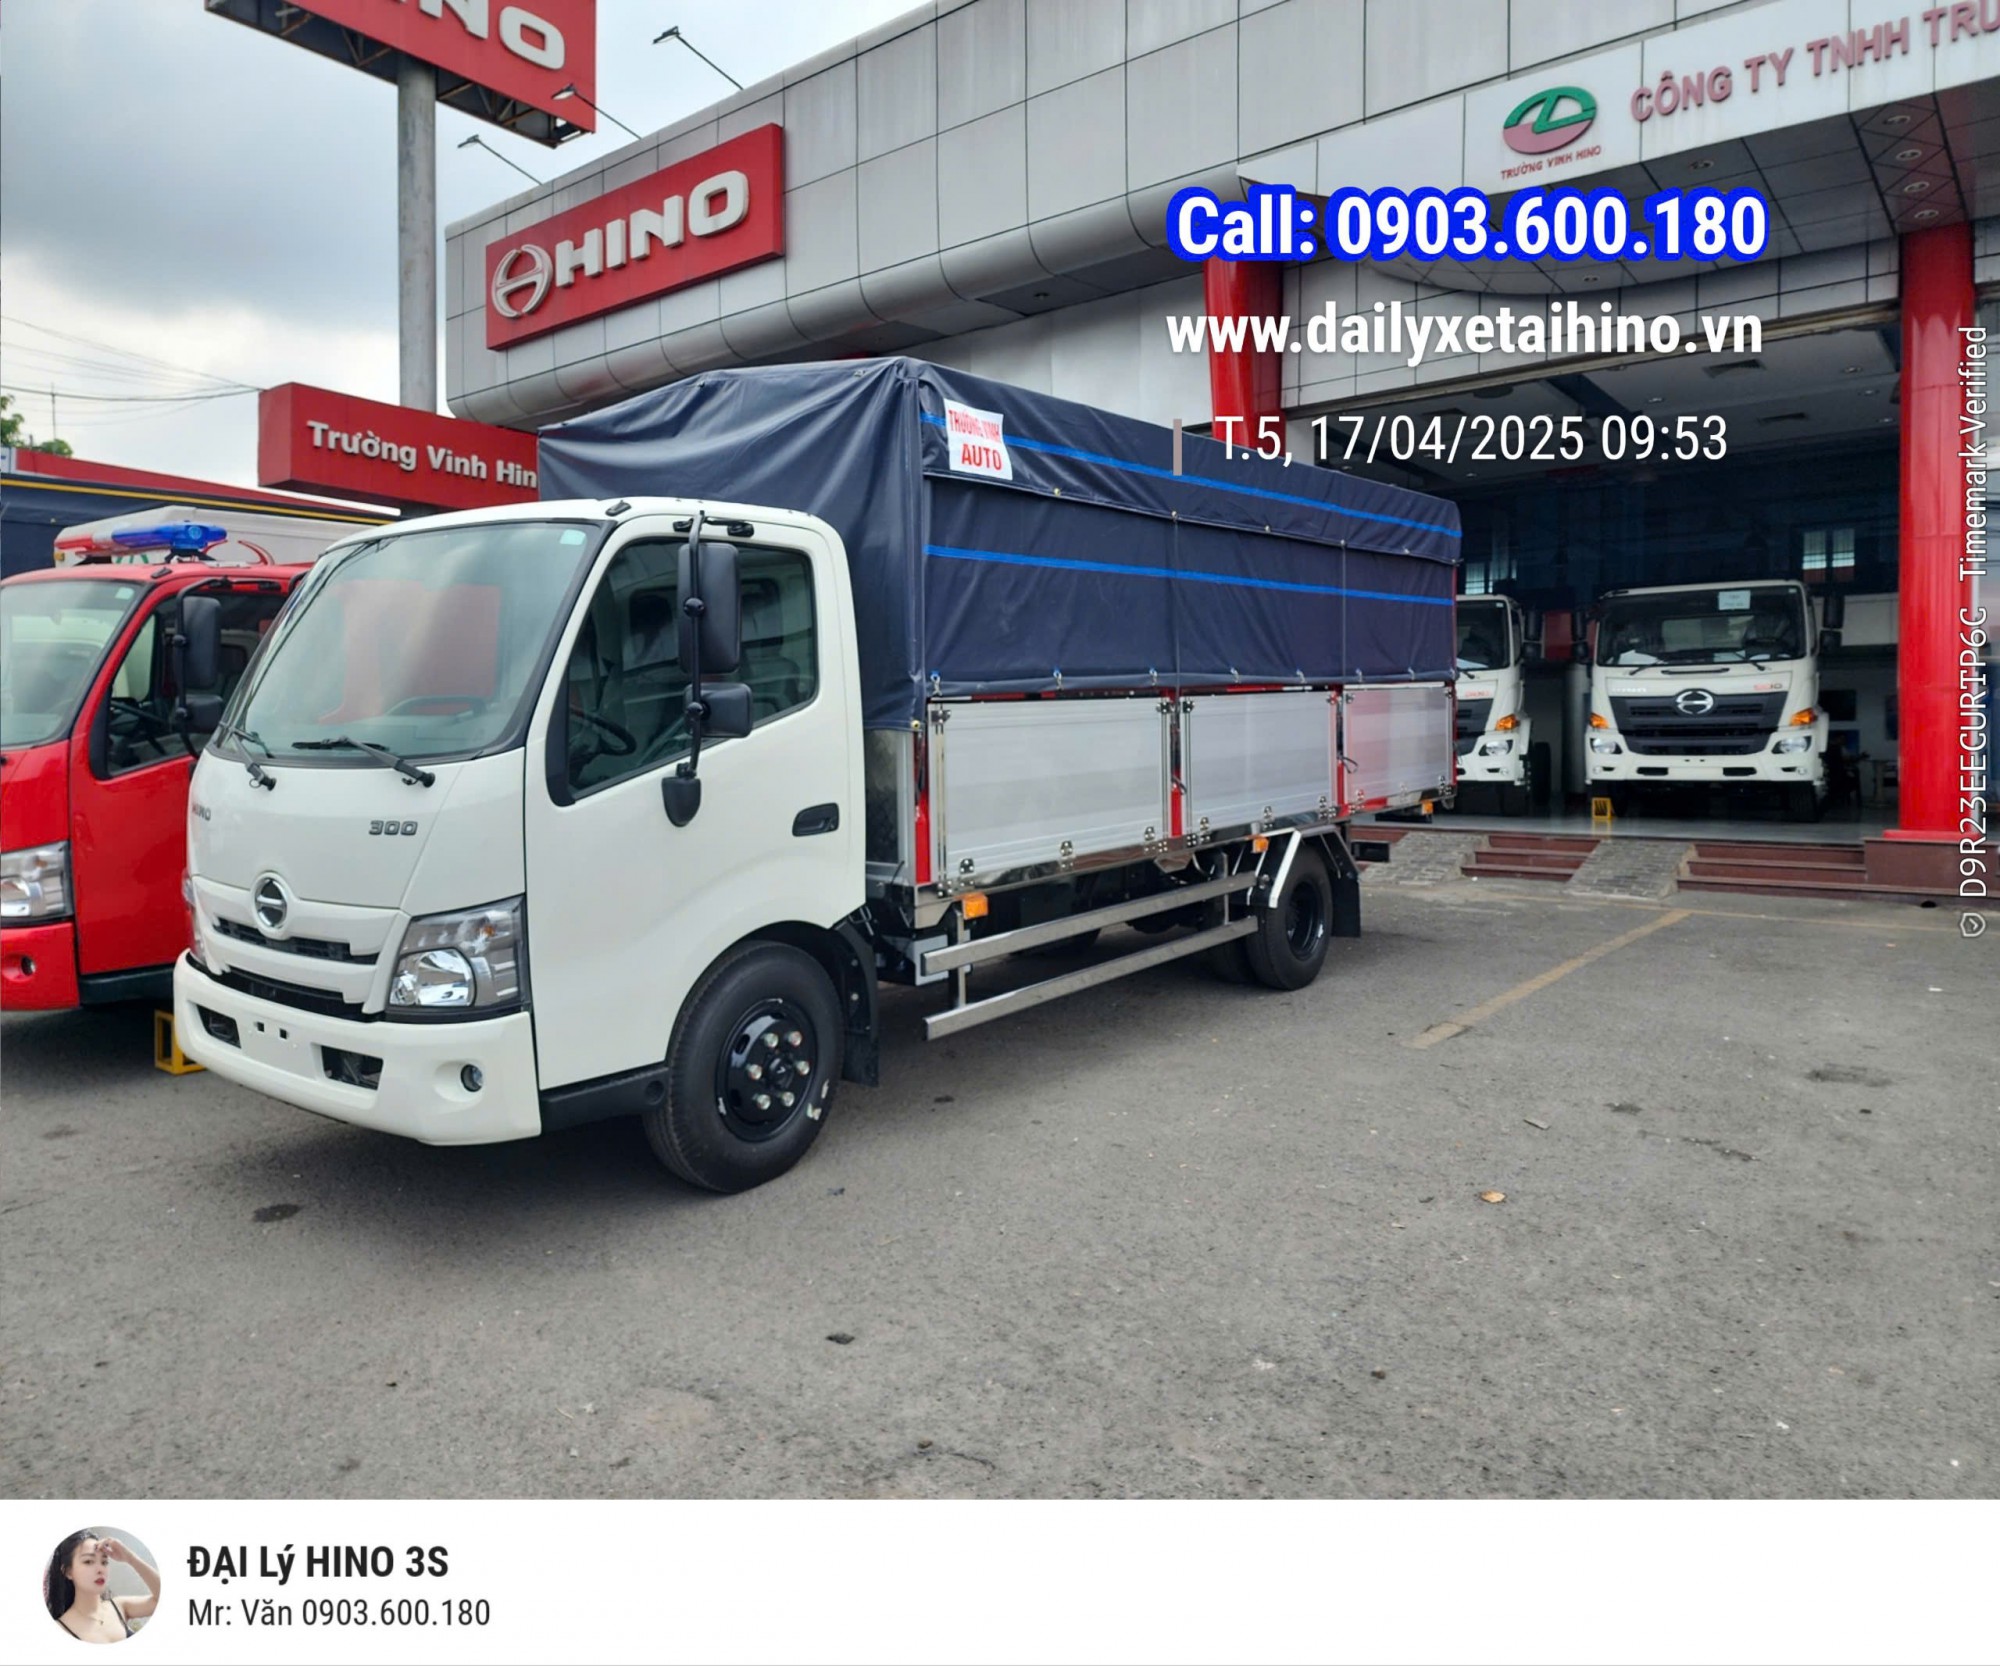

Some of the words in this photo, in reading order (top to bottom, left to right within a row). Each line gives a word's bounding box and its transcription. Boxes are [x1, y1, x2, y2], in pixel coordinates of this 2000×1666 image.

[1630, 69, 1733, 123] CÔNG
[1744, 46, 1795, 93] TY
[1805, 16, 1910, 77] TNHH
[1546, 152, 1573, 169] VINH
[1575, 144, 1602, 161] HINO
[554, 169, 750, 288] HINO
[306, 420, 417, 472] Trường
[427, 444, 488, 480] Vinh
[961, 443, 1003, 471] AUTO
[368, 819, 419, 836] 300
